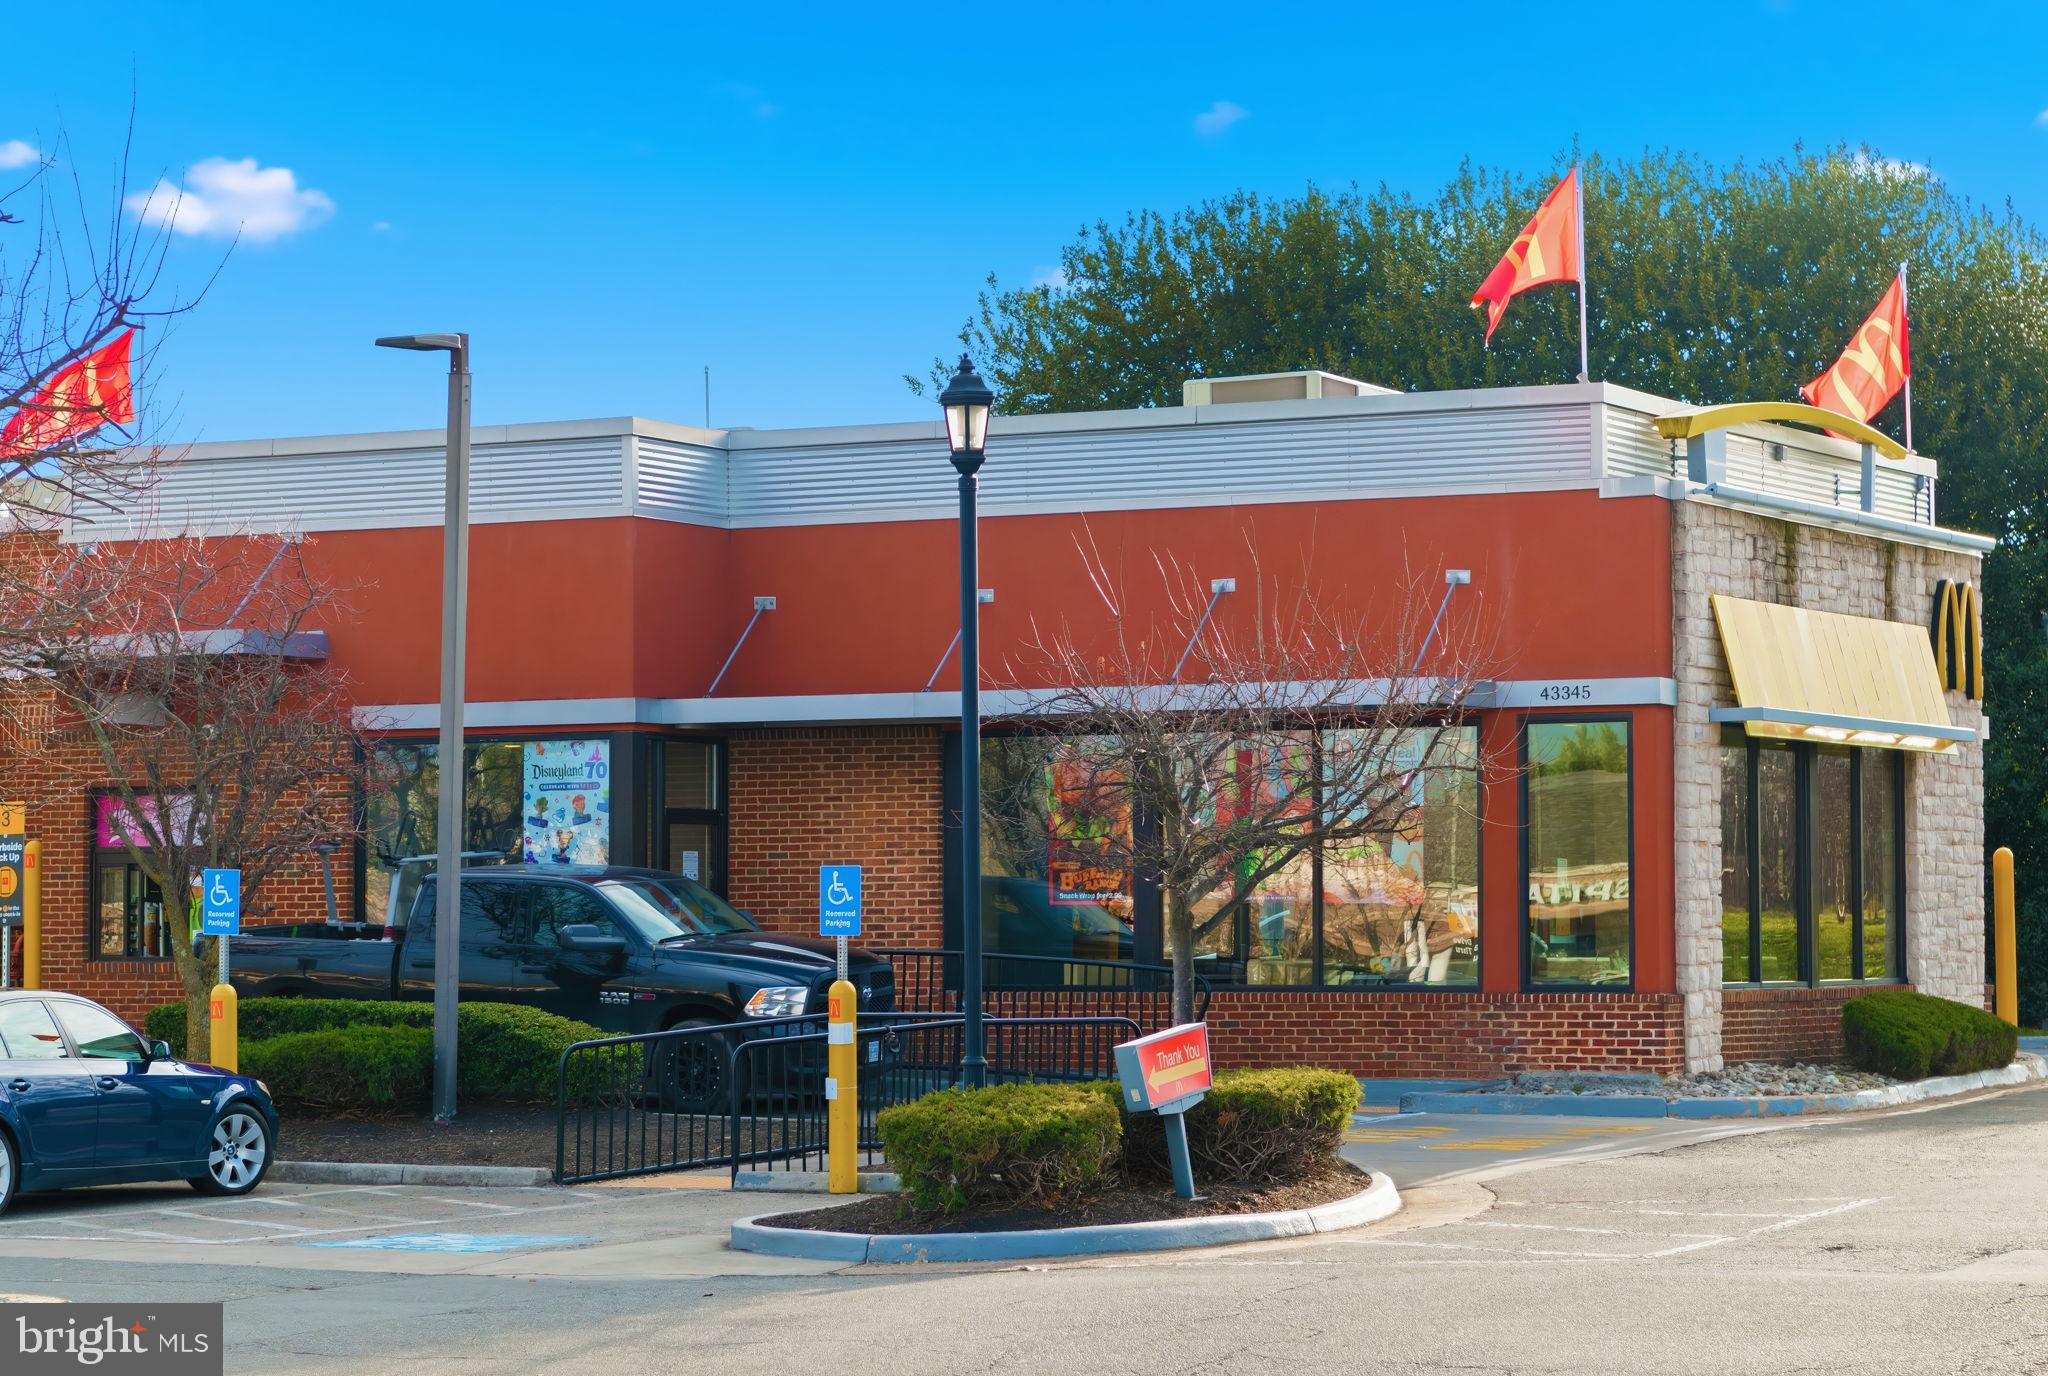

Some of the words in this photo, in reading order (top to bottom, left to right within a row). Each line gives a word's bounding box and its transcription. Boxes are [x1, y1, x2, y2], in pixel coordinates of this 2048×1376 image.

[1540, 685, 1591, 701] 43345
[532, 763, 584, 780] Disneyland
[584, 761, 608, 779] 70
[1, 811, 11, 827] 3
[9, 853, 20, 863] Up
[208, 910, 235, 918] Reserved
[825, 920, 851, 928] Parking
[600, 997, 630, 1005] 1500
[1156, 1047, 1184, 1069] Thank
[1183, 1043, 1201, 1061] You
